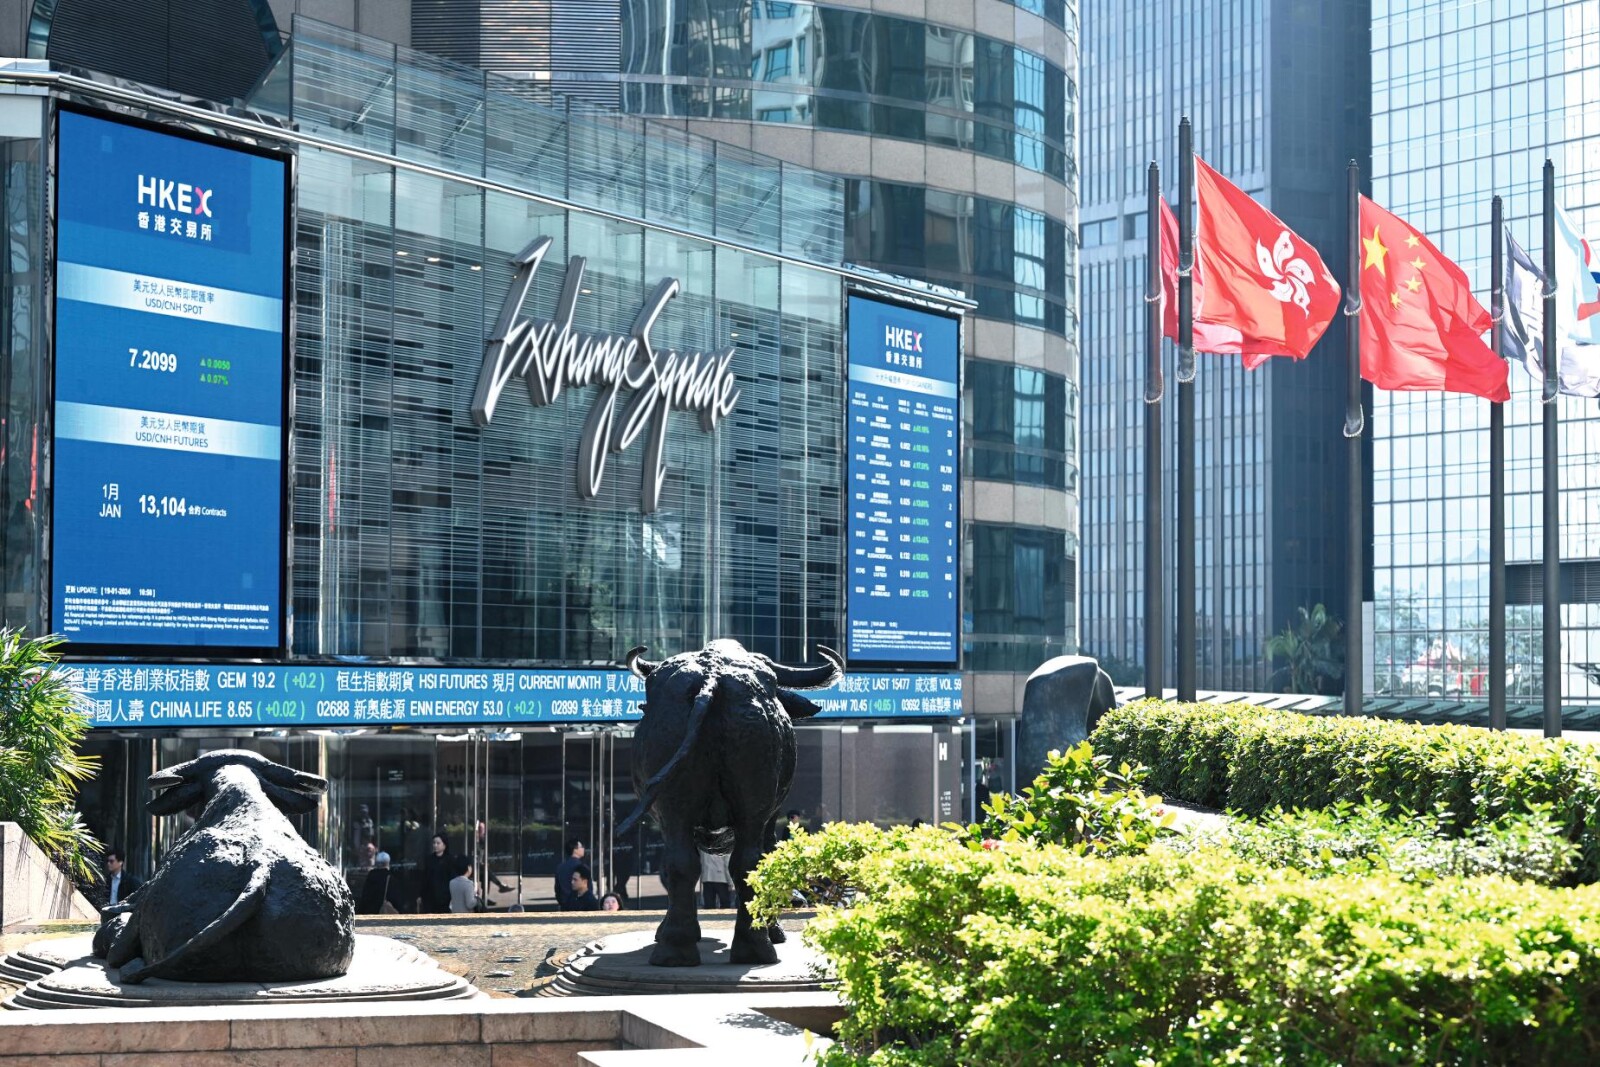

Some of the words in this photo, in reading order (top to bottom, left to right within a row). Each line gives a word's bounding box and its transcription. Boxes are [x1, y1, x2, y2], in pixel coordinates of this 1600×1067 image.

[138, 174, 212, 218] HKEX
[138, 212, 212, 241] 香港交易所
[145, 298, 182, 313] USD/CNH
[183, 302, 203, 315] SPOT
[886, 325, 922, 352] HKEX
[128, 348, 177, 372] 7.2099
[472, 236, 649, 498] Exchange
[615, 277, 741, 515] Square
[136, 433, 172, 444] USD/CNH
[174, 436, 208, 448] FUTURES
[102, 484, 119, 500] 1月
[99, 504, 121, 518] JAN
[139, 495, 186, 518] 13,104
[202, 506, 227, 517] Contracts
[218, 672, 246, 688] GEM
[252, 672, 275, 688] 19.2
[336, 671, 414, 692] 恒生指數期貨
[419, 675, 437, 689] HSI
[439, 675, 488, 690] FUTURES
[492, 673, 514, 692] 現月
[519, 675, 566, 690] CURRENT
[568, 675, 600, 690] MONTH
[872, 678, 889, 690] LAST
[940, 678, 952, 690] VOL
[151, 701, 192, 719] CHINA
[195, 701, 222, 718] LIFE
[227, 701, 252, 718] 8.65
[317, 701, 350, 717] 02688
[354, 699, 405, 720] 新奧能源
[410, 701, 434, 716] ENN
[436, 701, 479, 716] ENERGY
[483, 701, 503, 716] 53.0
[552, 700, 578, 715] 02899
[850, 699, 868, 712] 70.45
[939, 742, 948, 760] H
